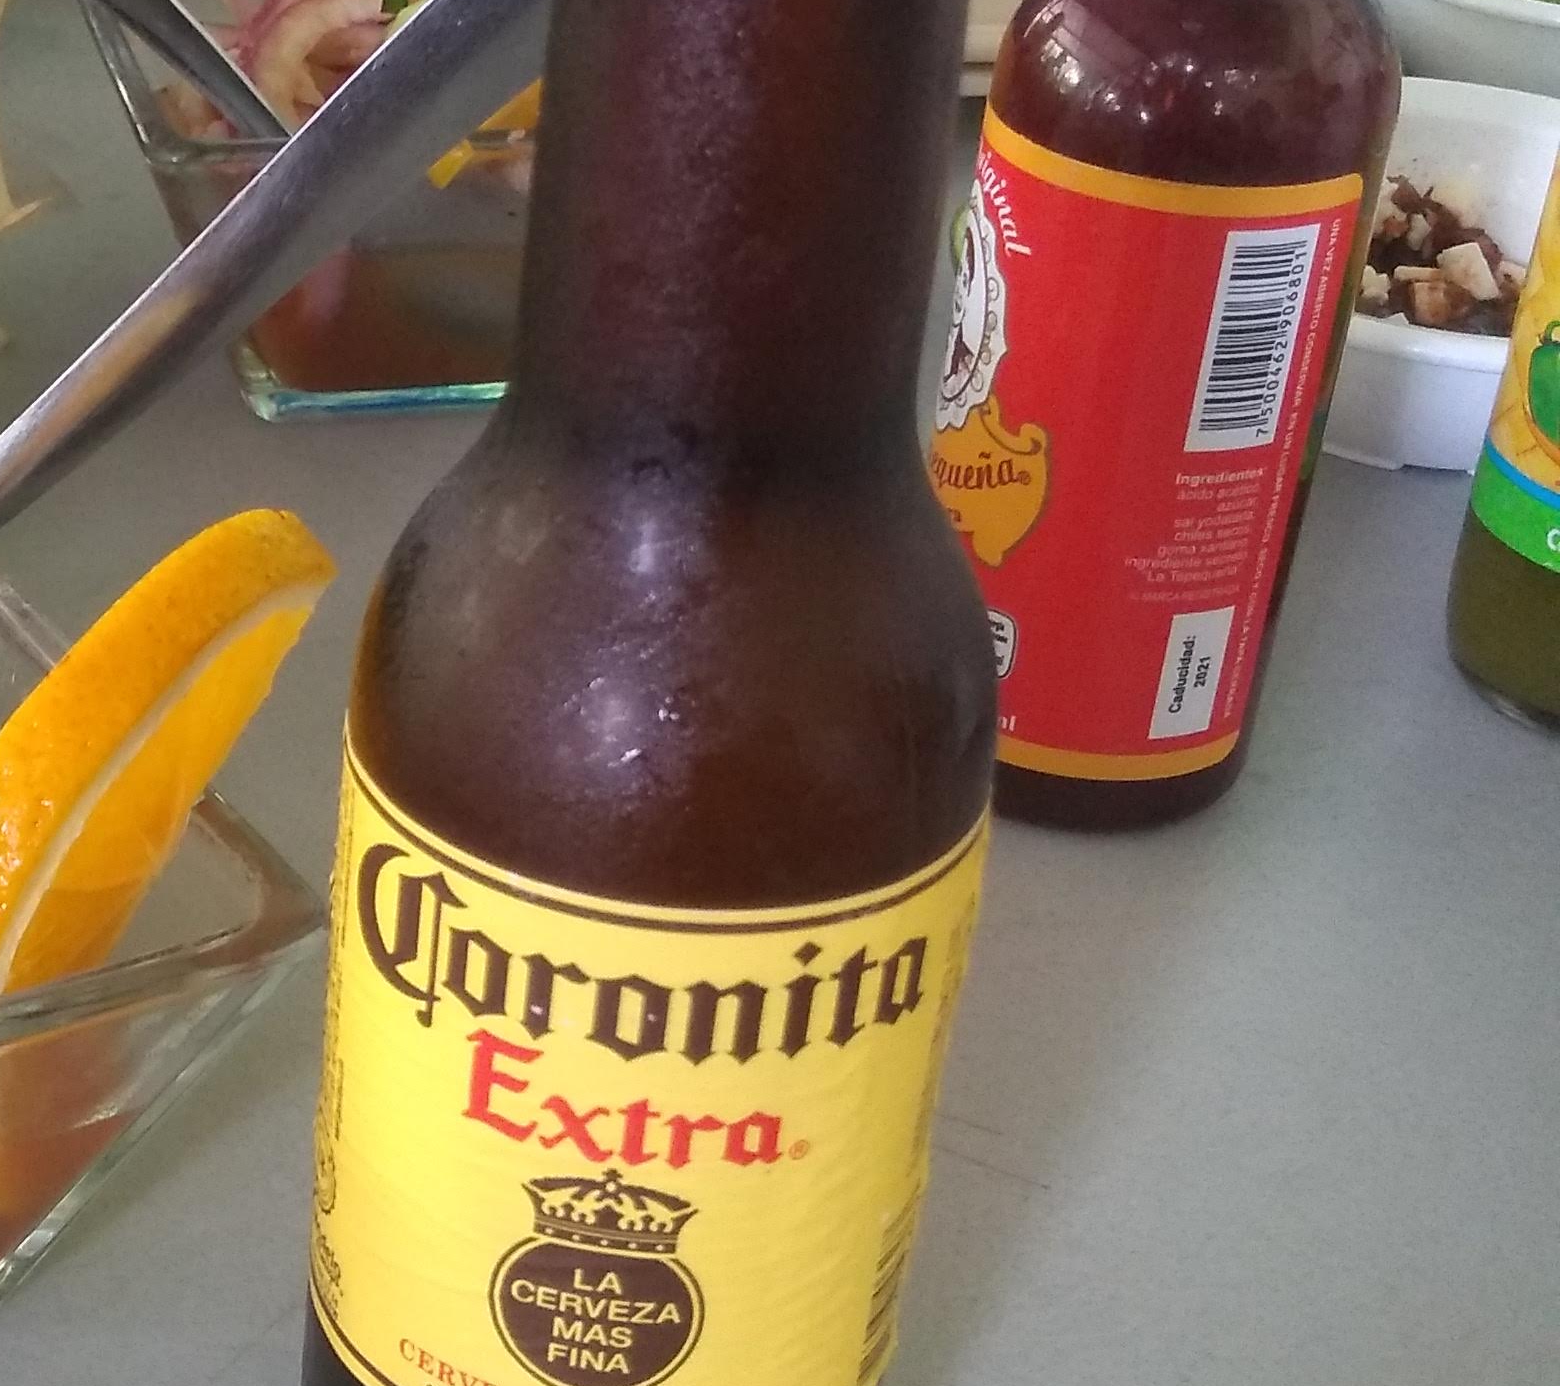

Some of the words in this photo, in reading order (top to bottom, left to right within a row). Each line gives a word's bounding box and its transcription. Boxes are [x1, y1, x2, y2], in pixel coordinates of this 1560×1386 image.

[1168, 634, 1196, 714] Caducidad:
[1193, 656, 1211, 688] 2021
[357, 843, 929, 1066] Coronita
[461, 1028, 785, 1169] Extra
[573, 1268, 623, 1295] LA
[510, 1279, 681, 1325] CERVEZA
[551, 1316, 634, 1349] MAS
[546, 1342, 631, 1374] FINA
